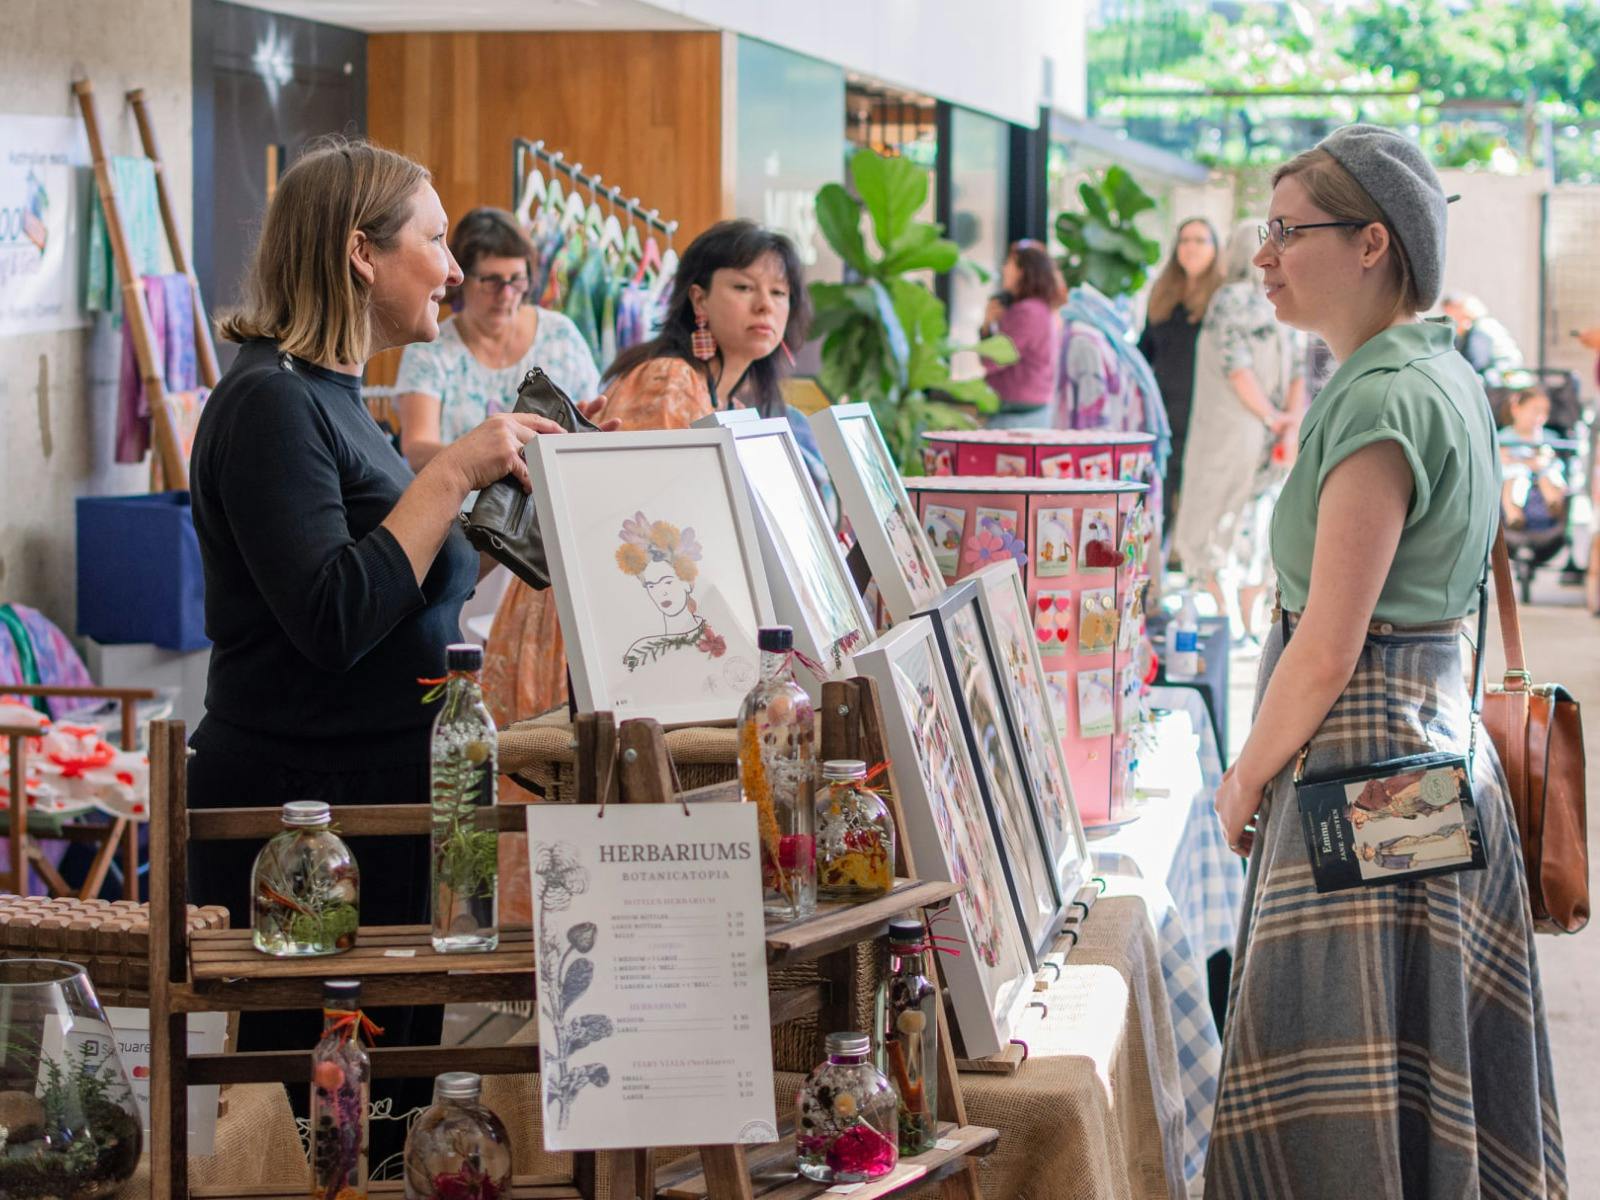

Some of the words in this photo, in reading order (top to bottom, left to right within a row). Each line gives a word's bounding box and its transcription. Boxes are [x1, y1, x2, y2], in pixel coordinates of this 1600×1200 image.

[1332, 809, 1343, 839] AUSTEN
[1321, 822, 1332, 854] Emma
[600, 842, 752, 863] HERBARIUMS
[1339, 841, 1348, 861] JANE
[622, 870, 730, 882] BOTANICATOPIA
